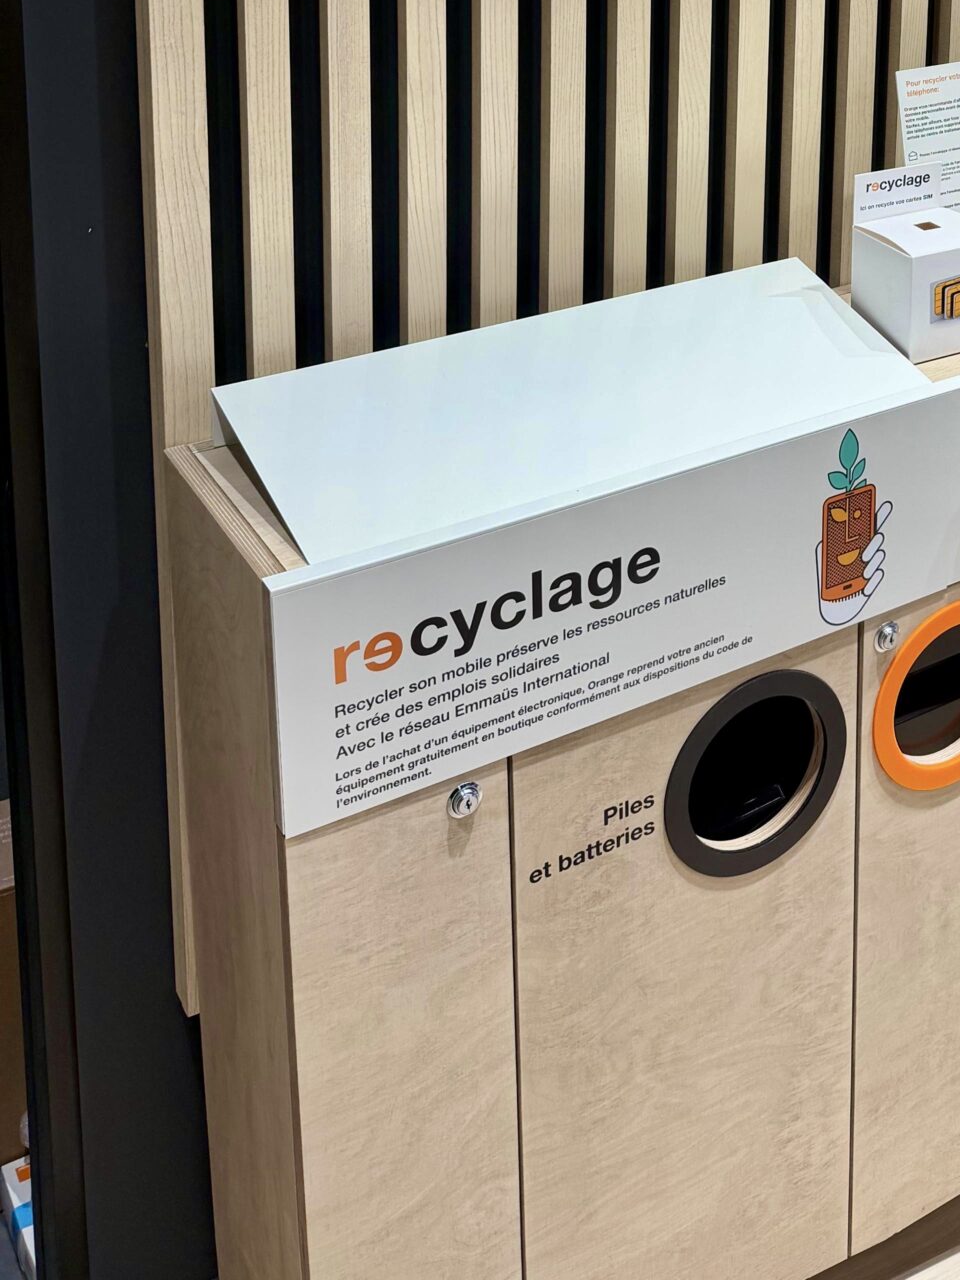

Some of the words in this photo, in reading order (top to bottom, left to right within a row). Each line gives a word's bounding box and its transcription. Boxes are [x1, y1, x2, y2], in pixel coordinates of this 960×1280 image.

[866, 173, 931, 193] recyclage
[332, 545, 661, 685] recyclage
[335, 686, 404, 718] Recycler
[409, 676, 436, 693] son
[442, 658, 492, 682] mobile
[497, 635, 558, 666] préserve
[563, 627, 582, 640] les
[587, 600, 660, 632] ressources
[665, 576, 726, 605] naturelles
[336, 724, 351, 738] et
[356, 712, 390, 731] crée
[395, 702, 423, 718] des
[428, 679, 486, 706] emplois
[492, 654, 559, 684] solidaires
[336, 738, 375, 759] Avec
[381, 732, 394, 743] le
[399, 712, 449, 737] réseau
[455, 688, 518, 717] Emmaüs
[524, 652, 609, 693] International
[336, 768, 361, 781] Lors
[365, 761, 379, 771] de
[383, 744, 421, 765] l'achat
[424, 736, 448, 750] d'un
[451, 711, 515, 740] équipement
[518, 688, 584, 716] électronique,
[588, 672, 624, 690] Orange
[627, 656, 664, 676] reprend
[668, 648, 691, 660] votre
[694, 635, 724, 651] ancien
[336, 764, 404, 794] équipement
[408, 736, 478, 770] gratuitement
[482, 732, 494, 742] en
[498, 714, 544, 736] boutique
[547, 685, 620, 718] conformément
[623, 678, 640, 689] aux
[643, 656, 700, 682] dispositions
[703, 651, 714, 660] du
[717, 642, 739, 654] code
[742, 636, 752, 645] de
[337, 768, 431, 808] l'environnement.
[603, 794, 655, 826] Piles
[529, 861, 552, 884] et
[558, 821, 655, 873] batteries
